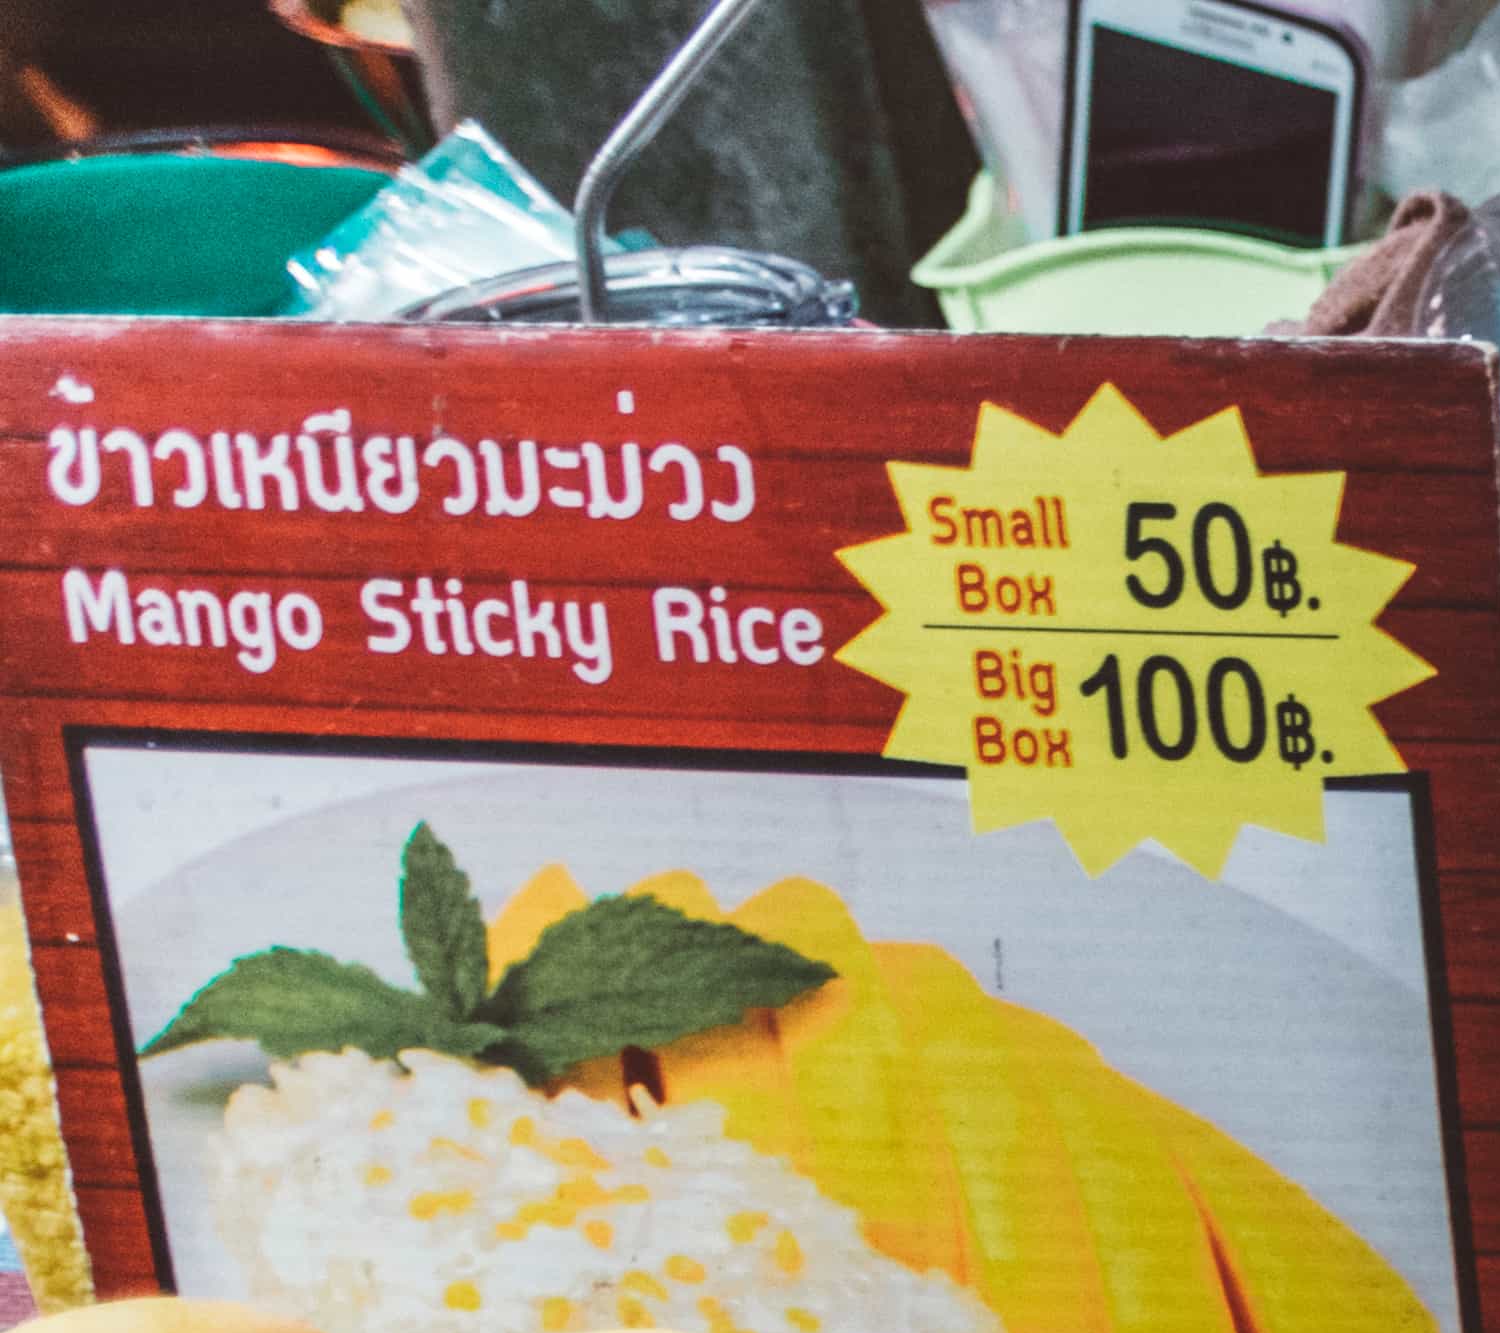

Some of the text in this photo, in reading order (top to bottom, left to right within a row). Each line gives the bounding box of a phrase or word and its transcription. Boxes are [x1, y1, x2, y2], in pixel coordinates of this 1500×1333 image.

[47, 374, 757, 523] ข้าวเหนียวมะม่วง
[930, 496, 1070, 550] Small
[956, 563, 1057, 616] Box
[61, 567, 825, 684] Mango Sticky Rice
[974, 650, 1057, 716] Big
[972, 716, 1073, 769] Box
